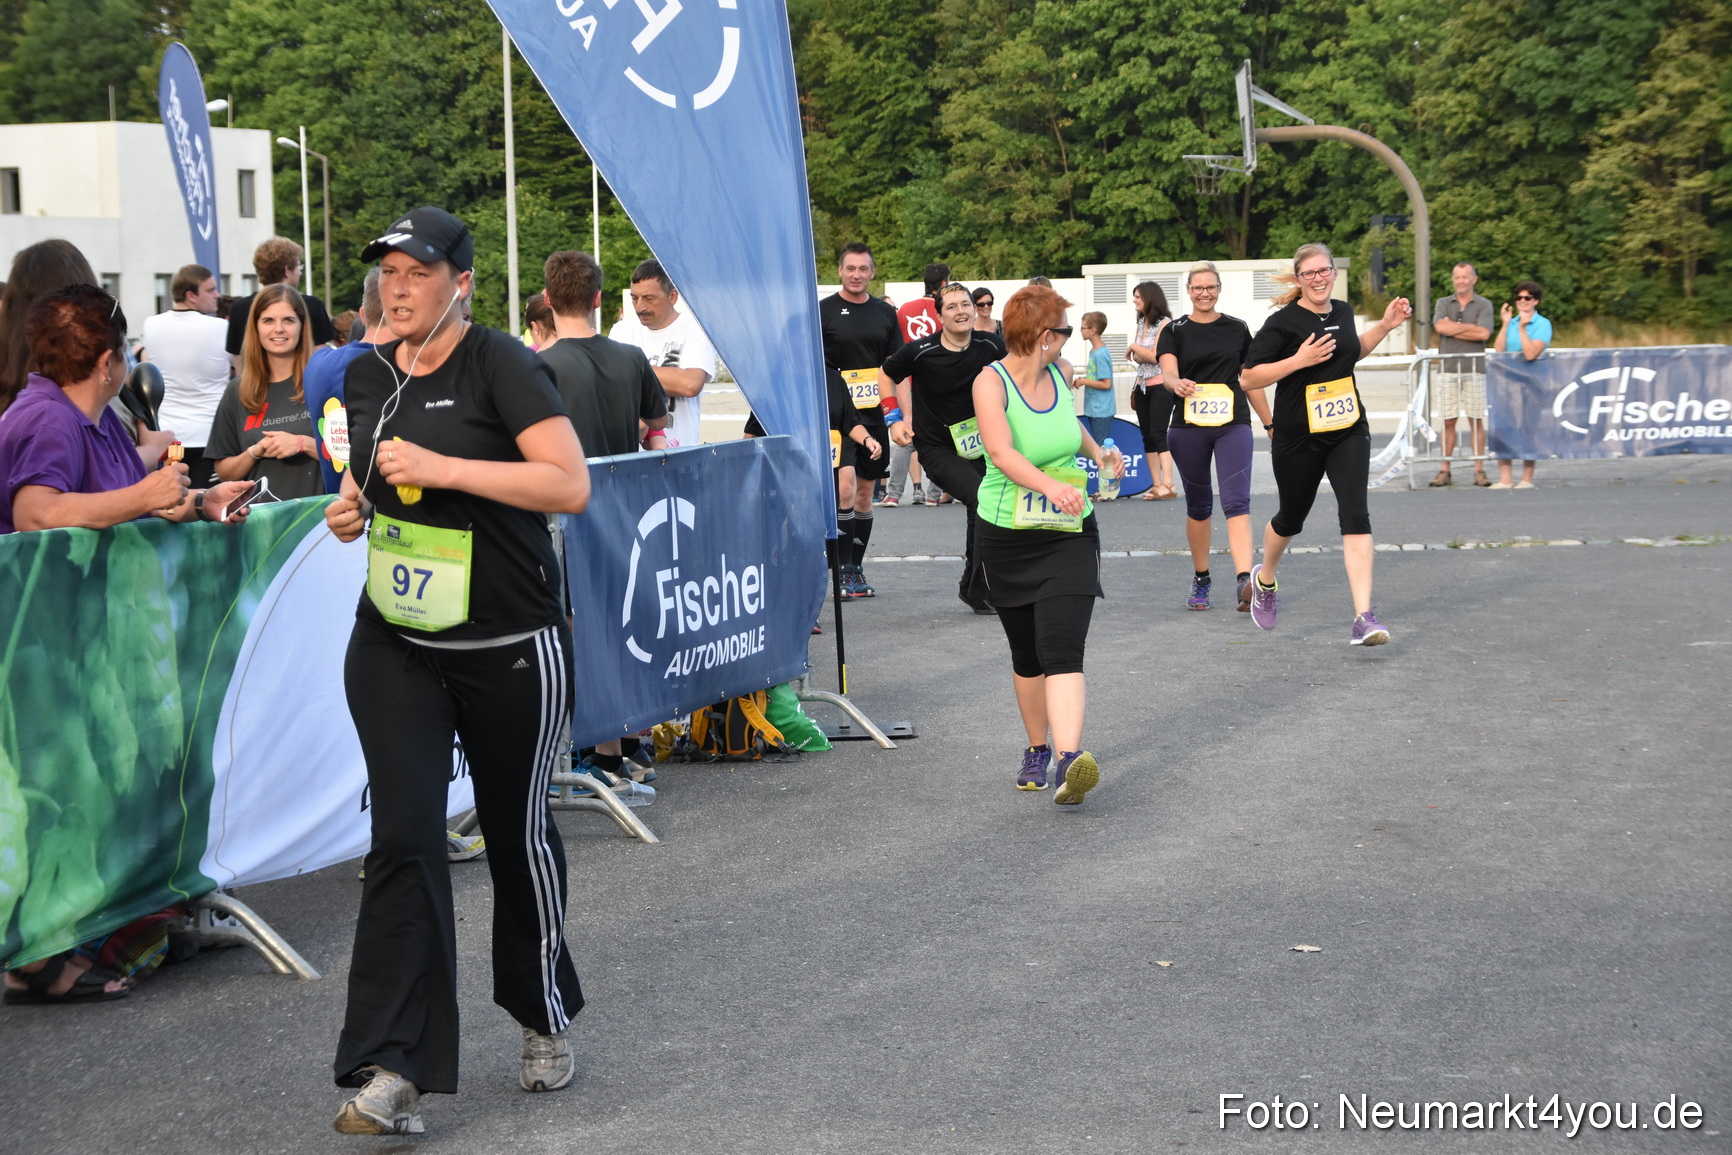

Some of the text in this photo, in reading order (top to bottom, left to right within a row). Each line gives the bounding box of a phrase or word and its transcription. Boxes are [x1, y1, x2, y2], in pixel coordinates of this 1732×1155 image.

[848, 384, 879, 398] 1236
[1190, 400, 1228, 414] 1232
[1314, 397, 1354, 418] 1233
[1588, 392, 1732, 425] Fische
[392, 563, 434, 600] 97
[395, 602, 427, 615] Eva Müller
[663, 625, 765, 679] AUTOMOBILE
